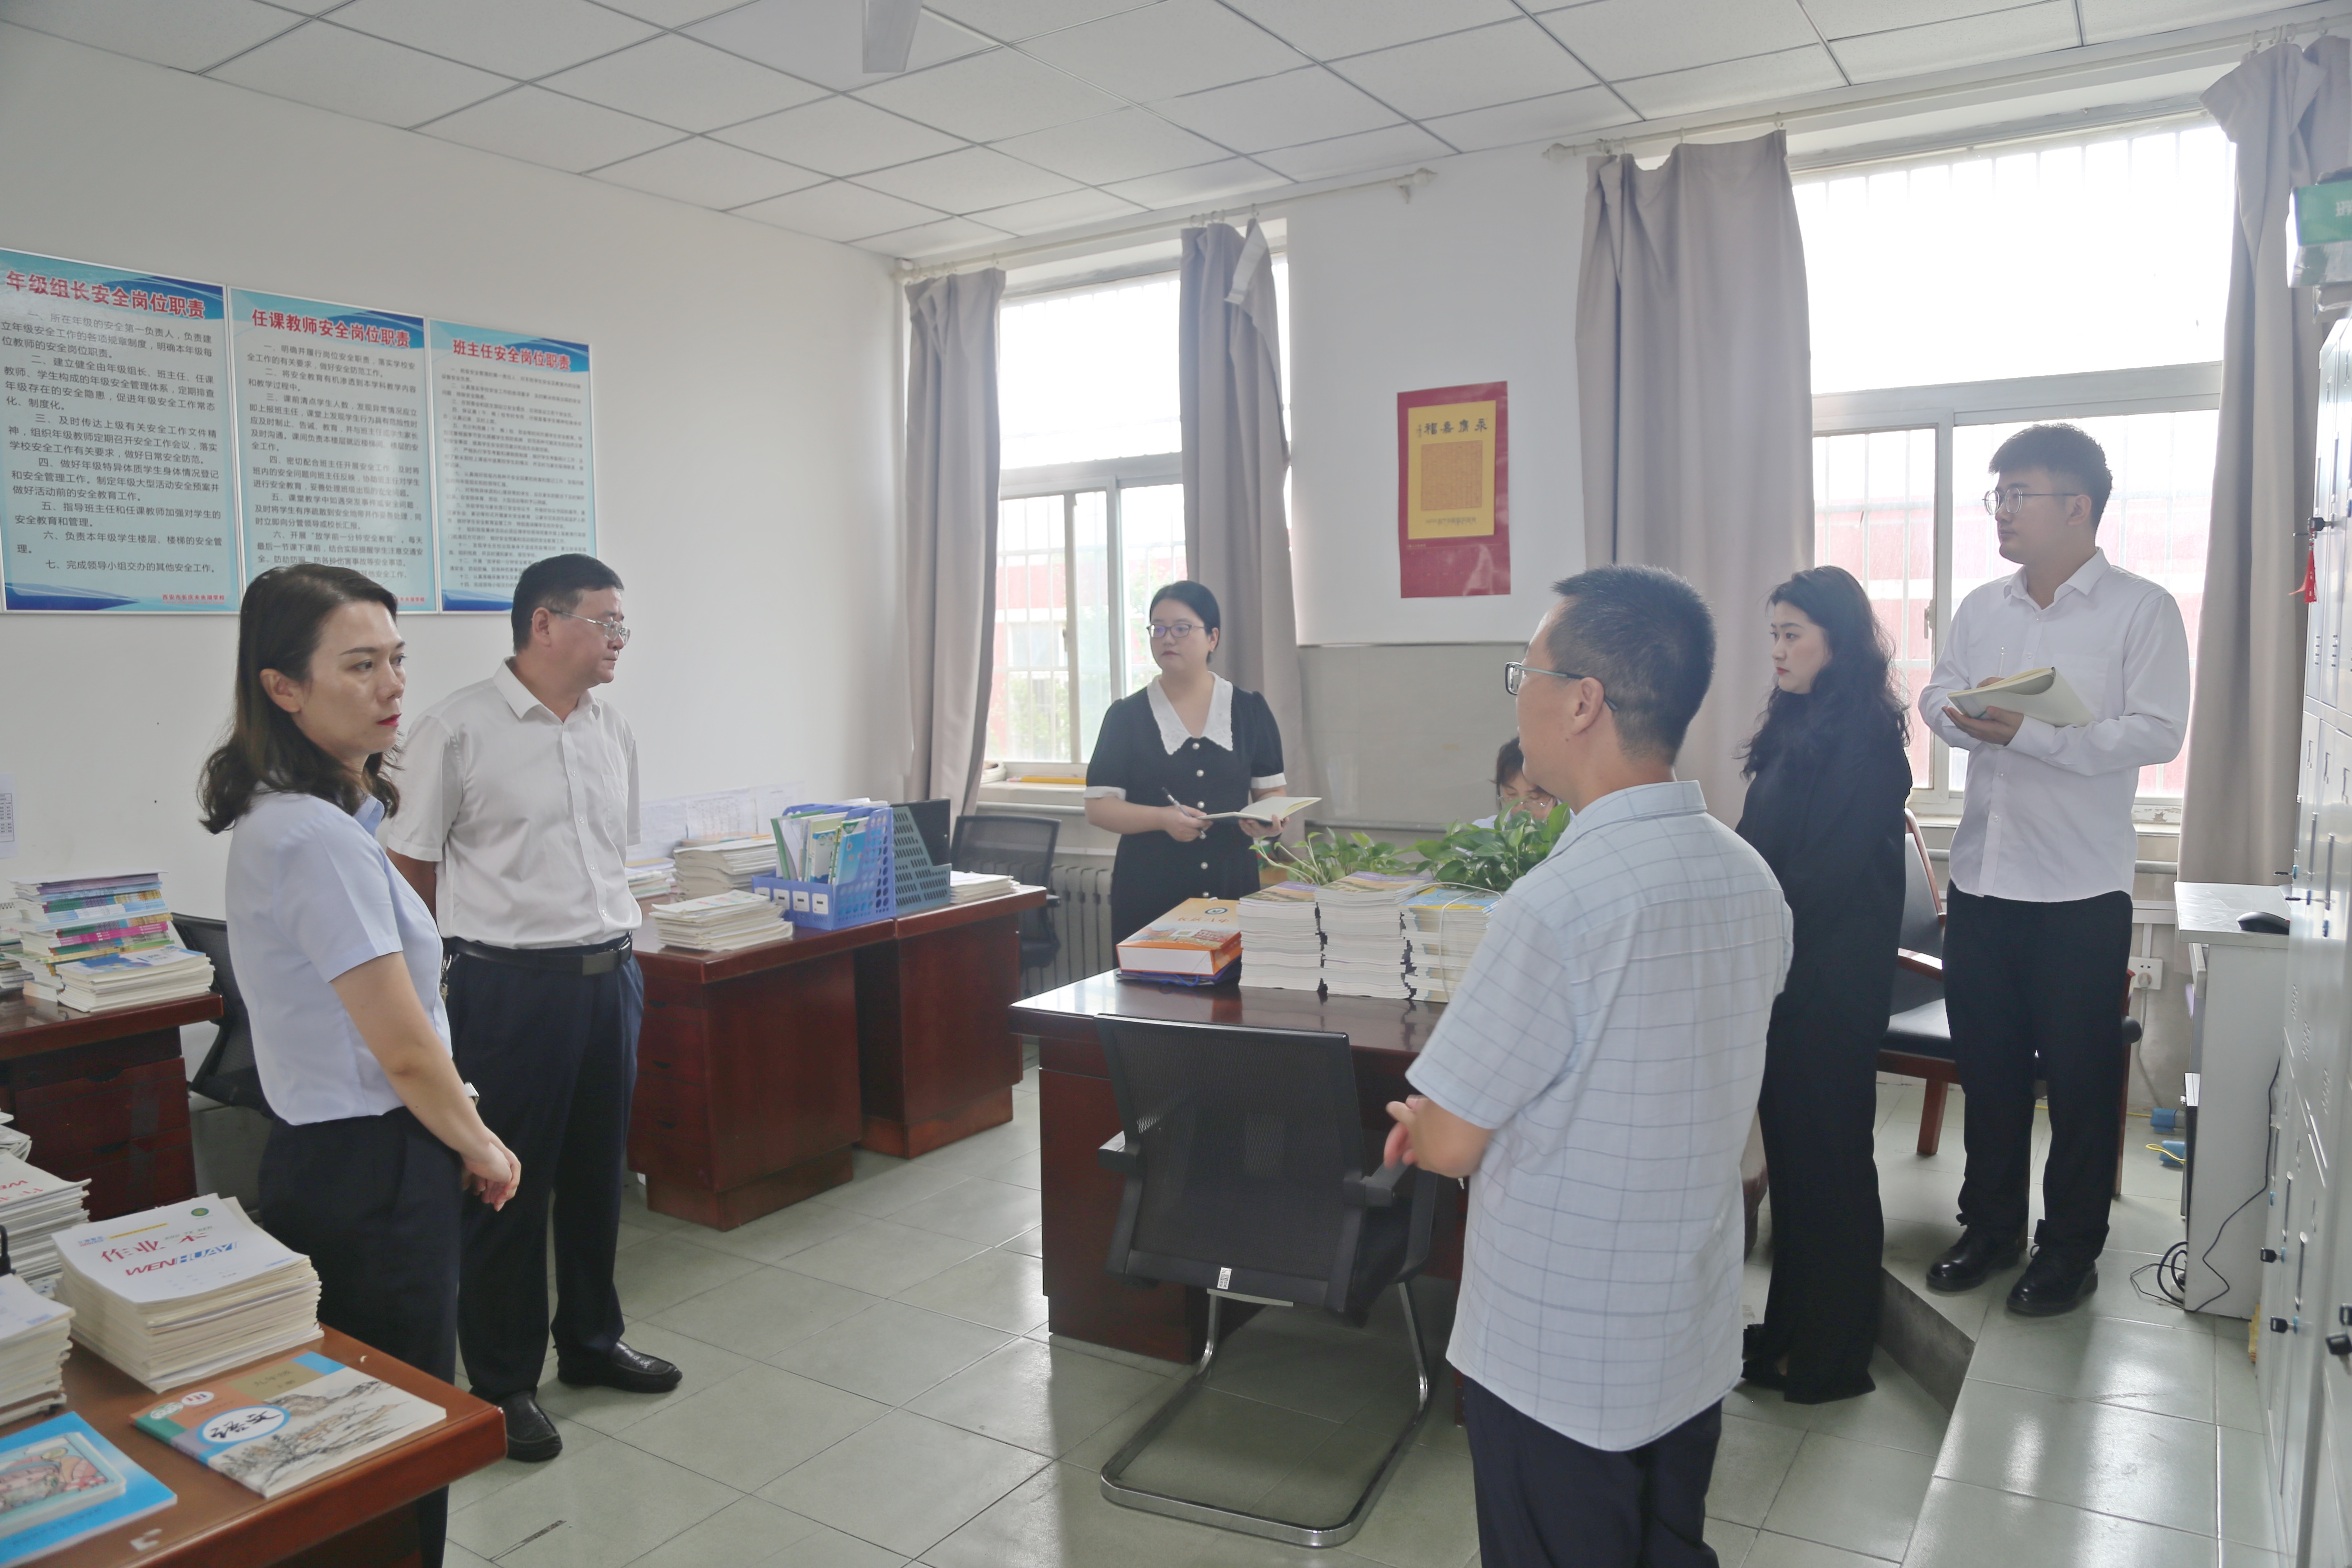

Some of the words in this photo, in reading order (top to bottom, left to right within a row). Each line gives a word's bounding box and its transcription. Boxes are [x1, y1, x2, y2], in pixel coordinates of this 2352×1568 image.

[6, 270, 205, 319] 年级组长安全岗位职责
[251, 309, 410, 348] 任课教师安全岗位职责
[2, 336, 113, 358] 位教师的安全岗位职责。
[452, 339, 571, 371] 班主任安全岗位职责
[6, 395, 64, 410] 化、制度化。
[13, 485, 141, 502] 做好活动前的安全教育工作。
[15, 514, 93, 527] 安全教育和管理。
[17, 544, 32, 554] 理。
[210, 1410, 283, 1439] 语文
